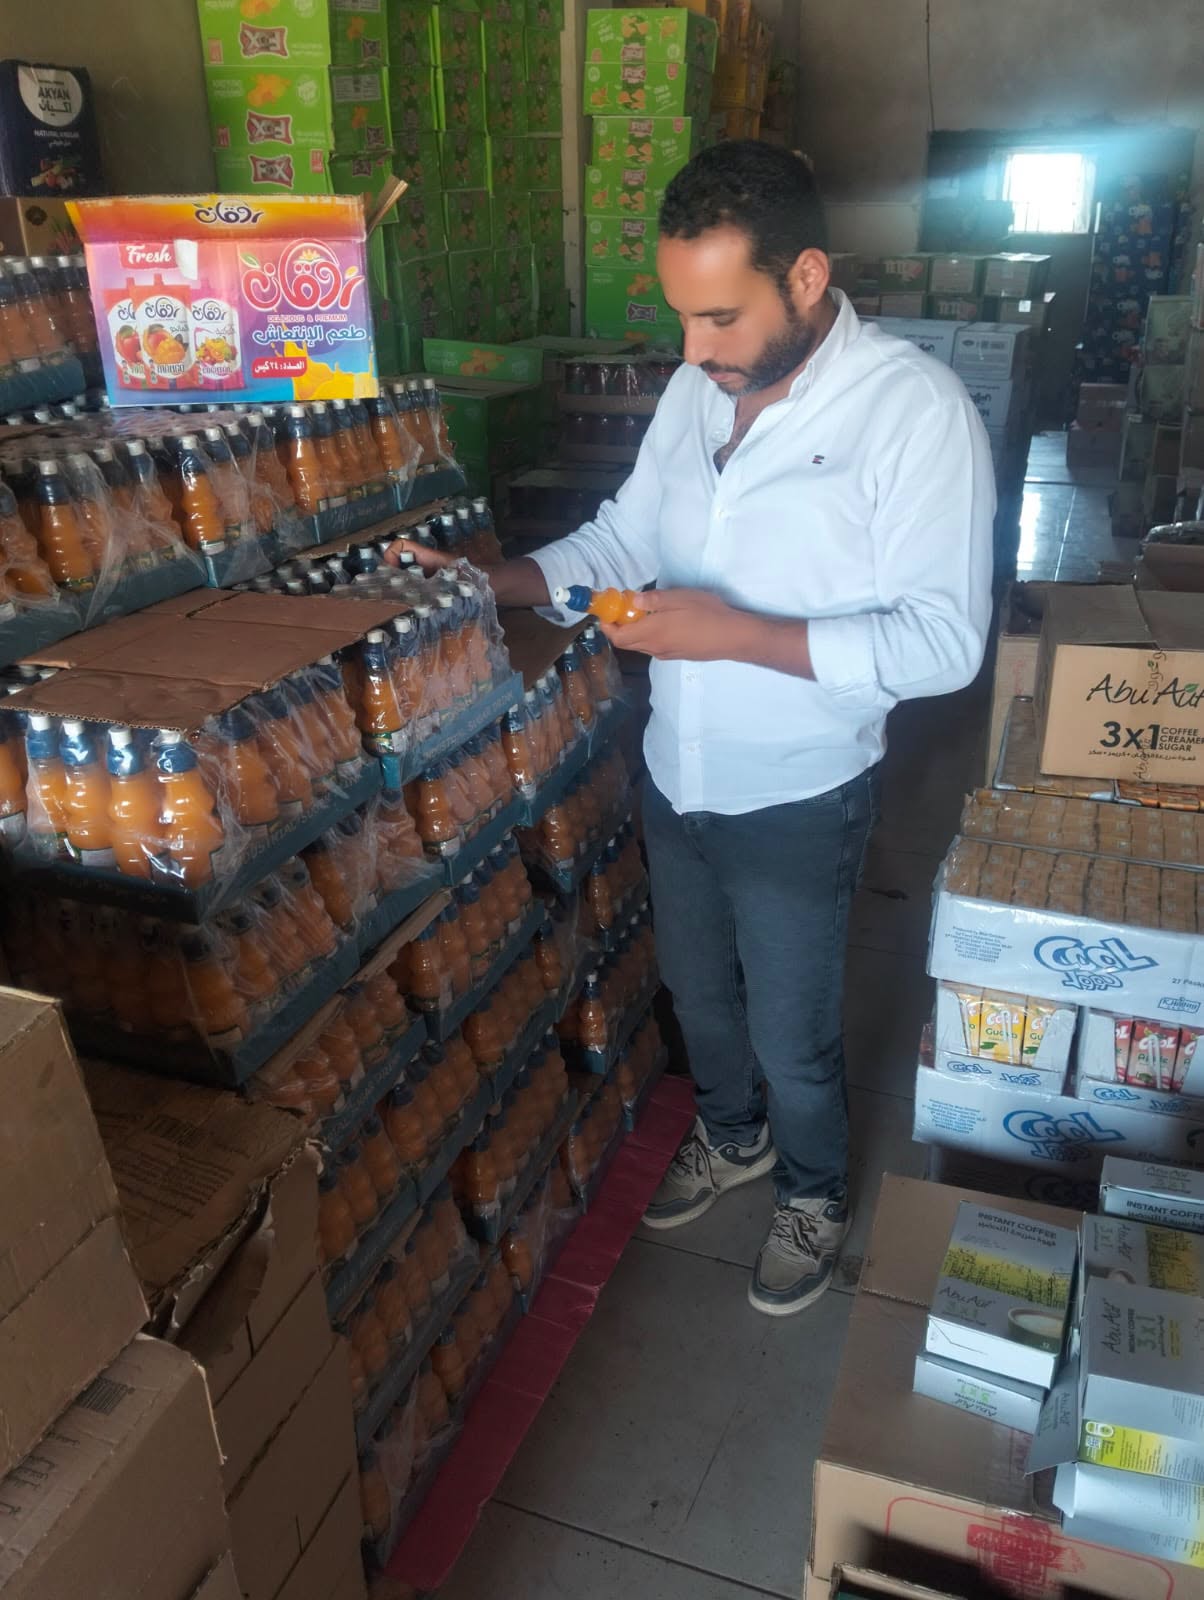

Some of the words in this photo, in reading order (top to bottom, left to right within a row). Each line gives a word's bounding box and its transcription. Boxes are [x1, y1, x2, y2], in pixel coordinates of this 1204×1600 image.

[38, 87, 71, 100] AKYAN
[126, 244, 171, 264] Fresh
[315, 314, 347, 322] PREMIUM
[327, 325, 367, 344] طعم
[1086, 673, 1151, 705] Abu
[1100, 721, 1160, 750] 3x1
[1161, 727, 1199, 736] COFFEE
[1158, 743, 1192, 752] SUGAR
[986, 1010, 1019, 1026] COL
[985, 1027, 1018, 1040] Guaa
[1138, 1036, 1177, 1050] COL
[1127, 1201, 1167, 1215] INSTANT
[978, 1212, 1016, 1227] INSTANT
[1017, 1222, 1057, 1240] COFFEE
